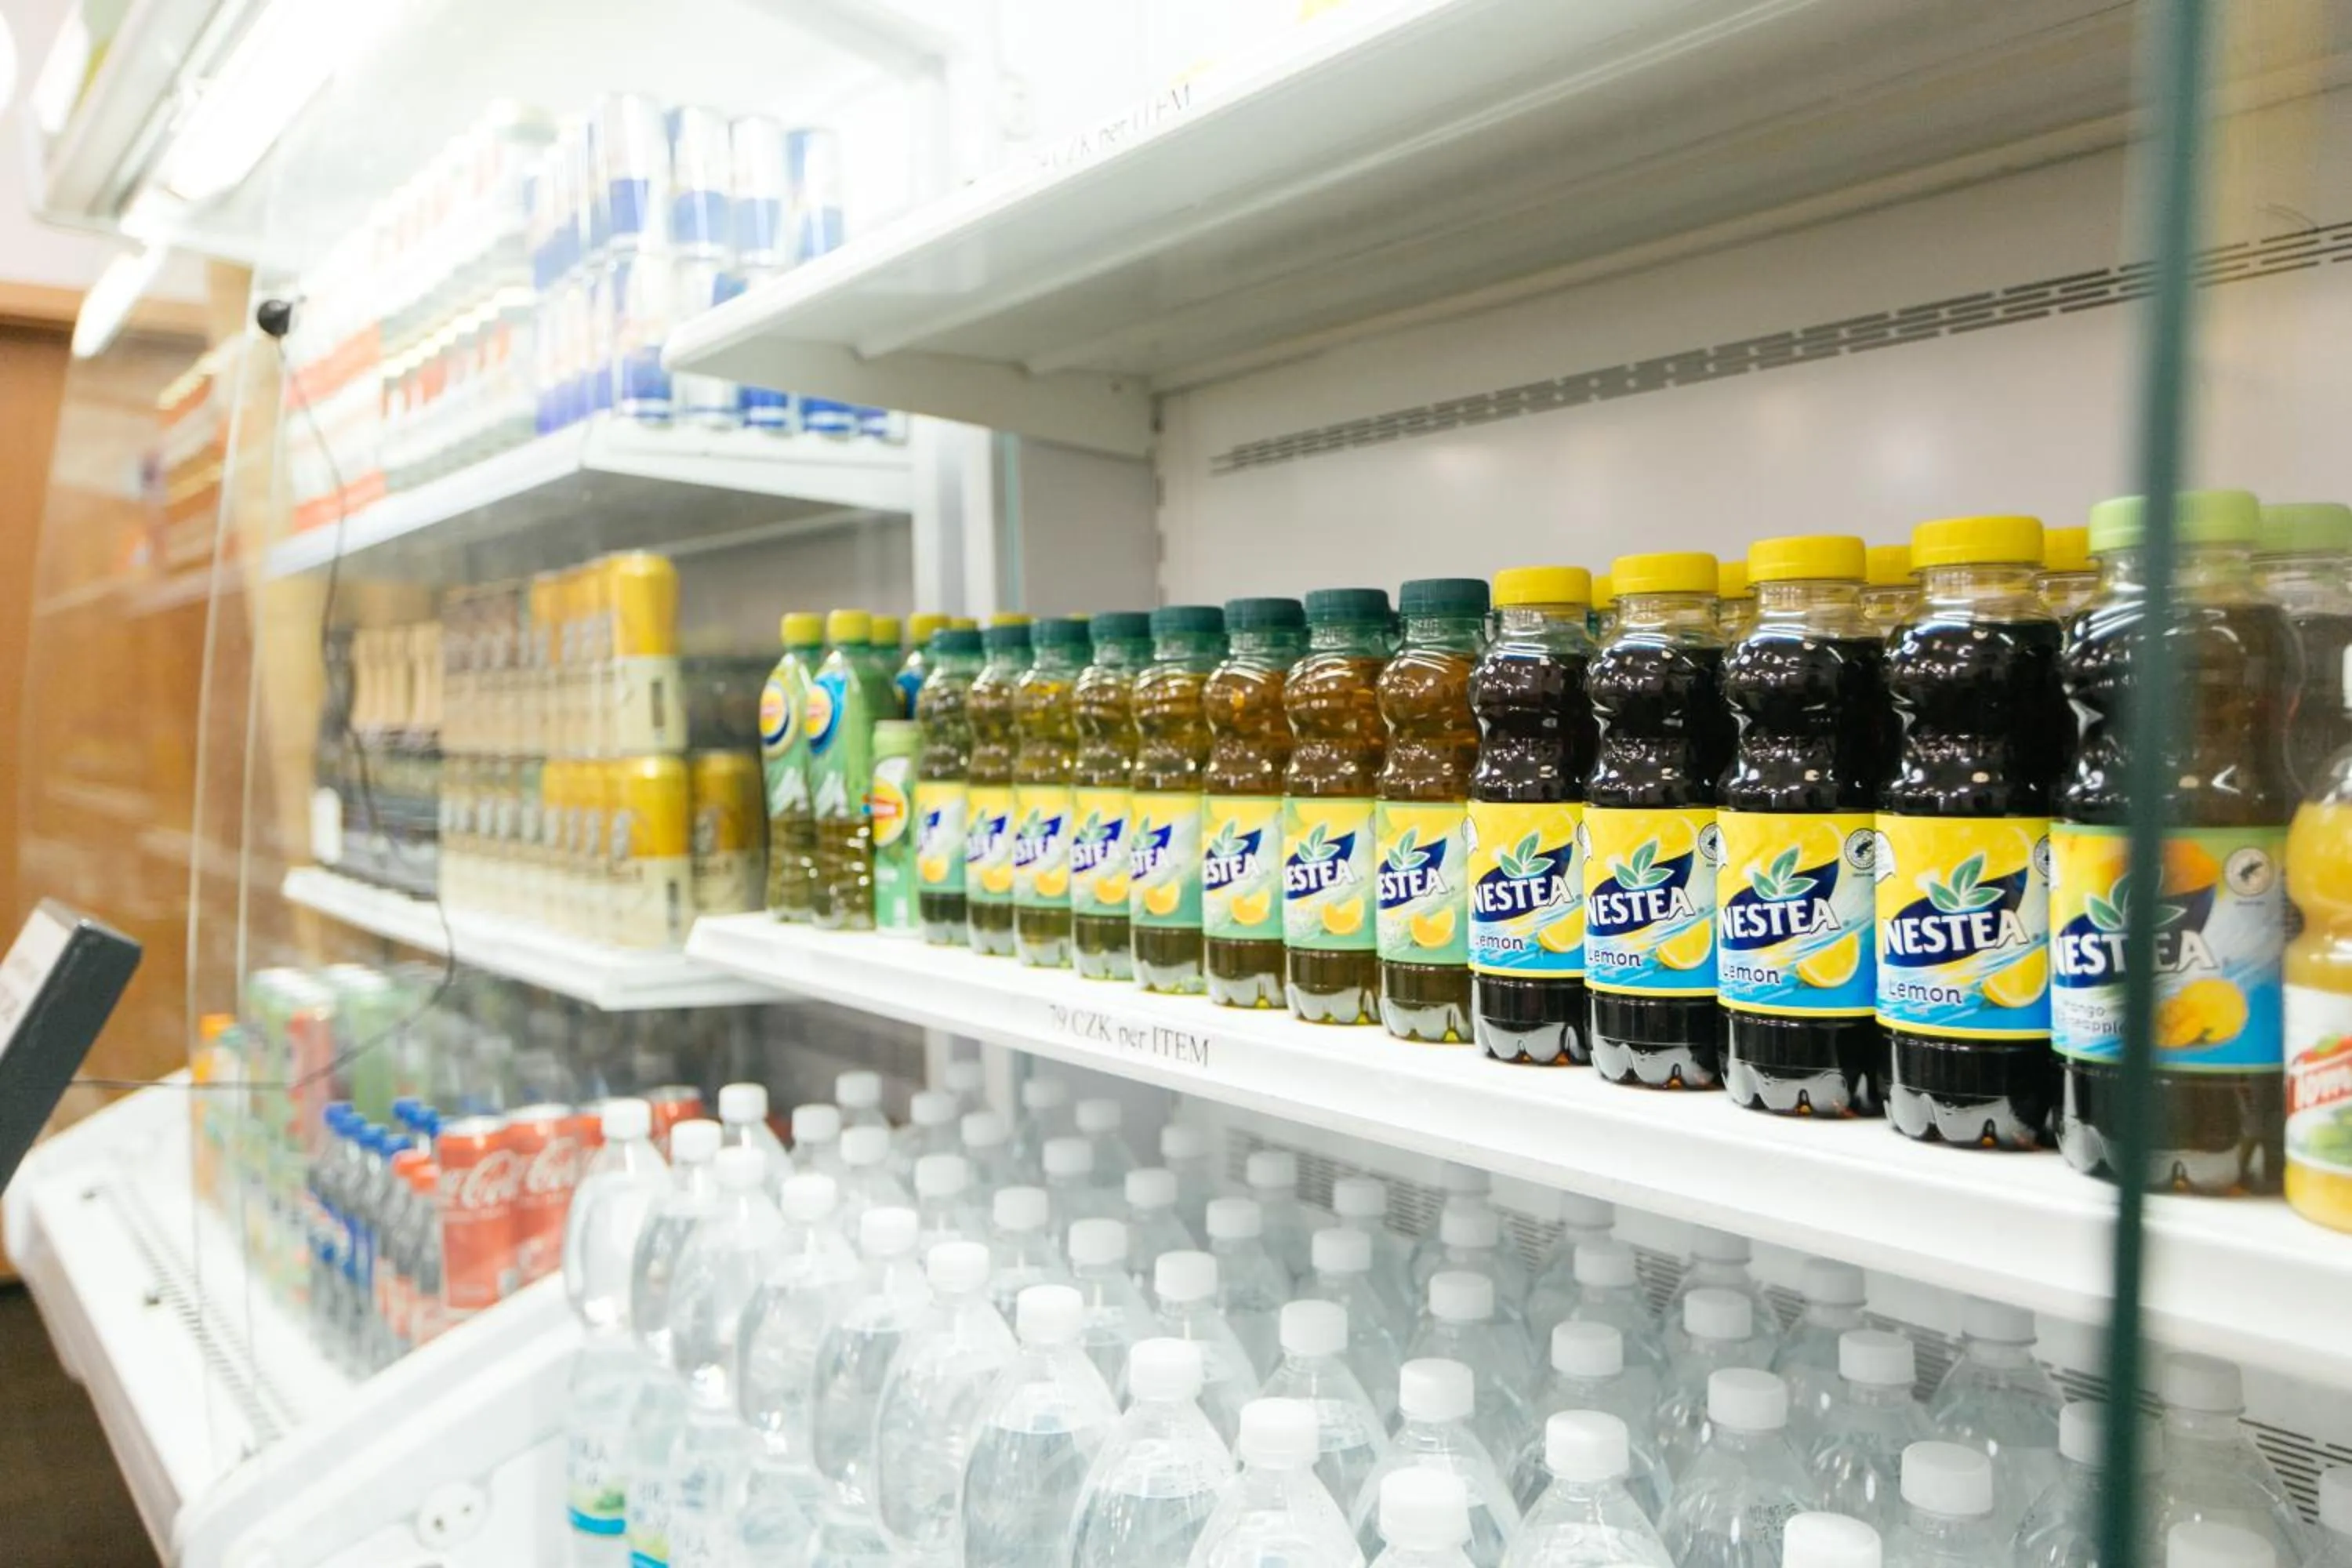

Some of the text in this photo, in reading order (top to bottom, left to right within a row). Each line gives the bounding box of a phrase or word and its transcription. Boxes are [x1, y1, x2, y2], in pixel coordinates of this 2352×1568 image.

[1203, 853, 1261, 884] ESTEA
[1284, 859, 1355, 891] ESTEA
[1377, 868, 1449, 901] ESTEA
[1473, 875, 1574, 913] NESTEA
[1586, 887, 1696, 927] NESTEA
[1720, 898, 1842, 939] NESTEA
[1882, 909, 2030, 956] NESTEA
[1475, 933, 1525, 950] emon
[1889, 978, 1962, 1004] Lemon
[1072, 1009, 1112, 1042] CZK
[1119, 1025, 1148, 1052] per
[1152, 1025, 1210, 1068] ITEM
